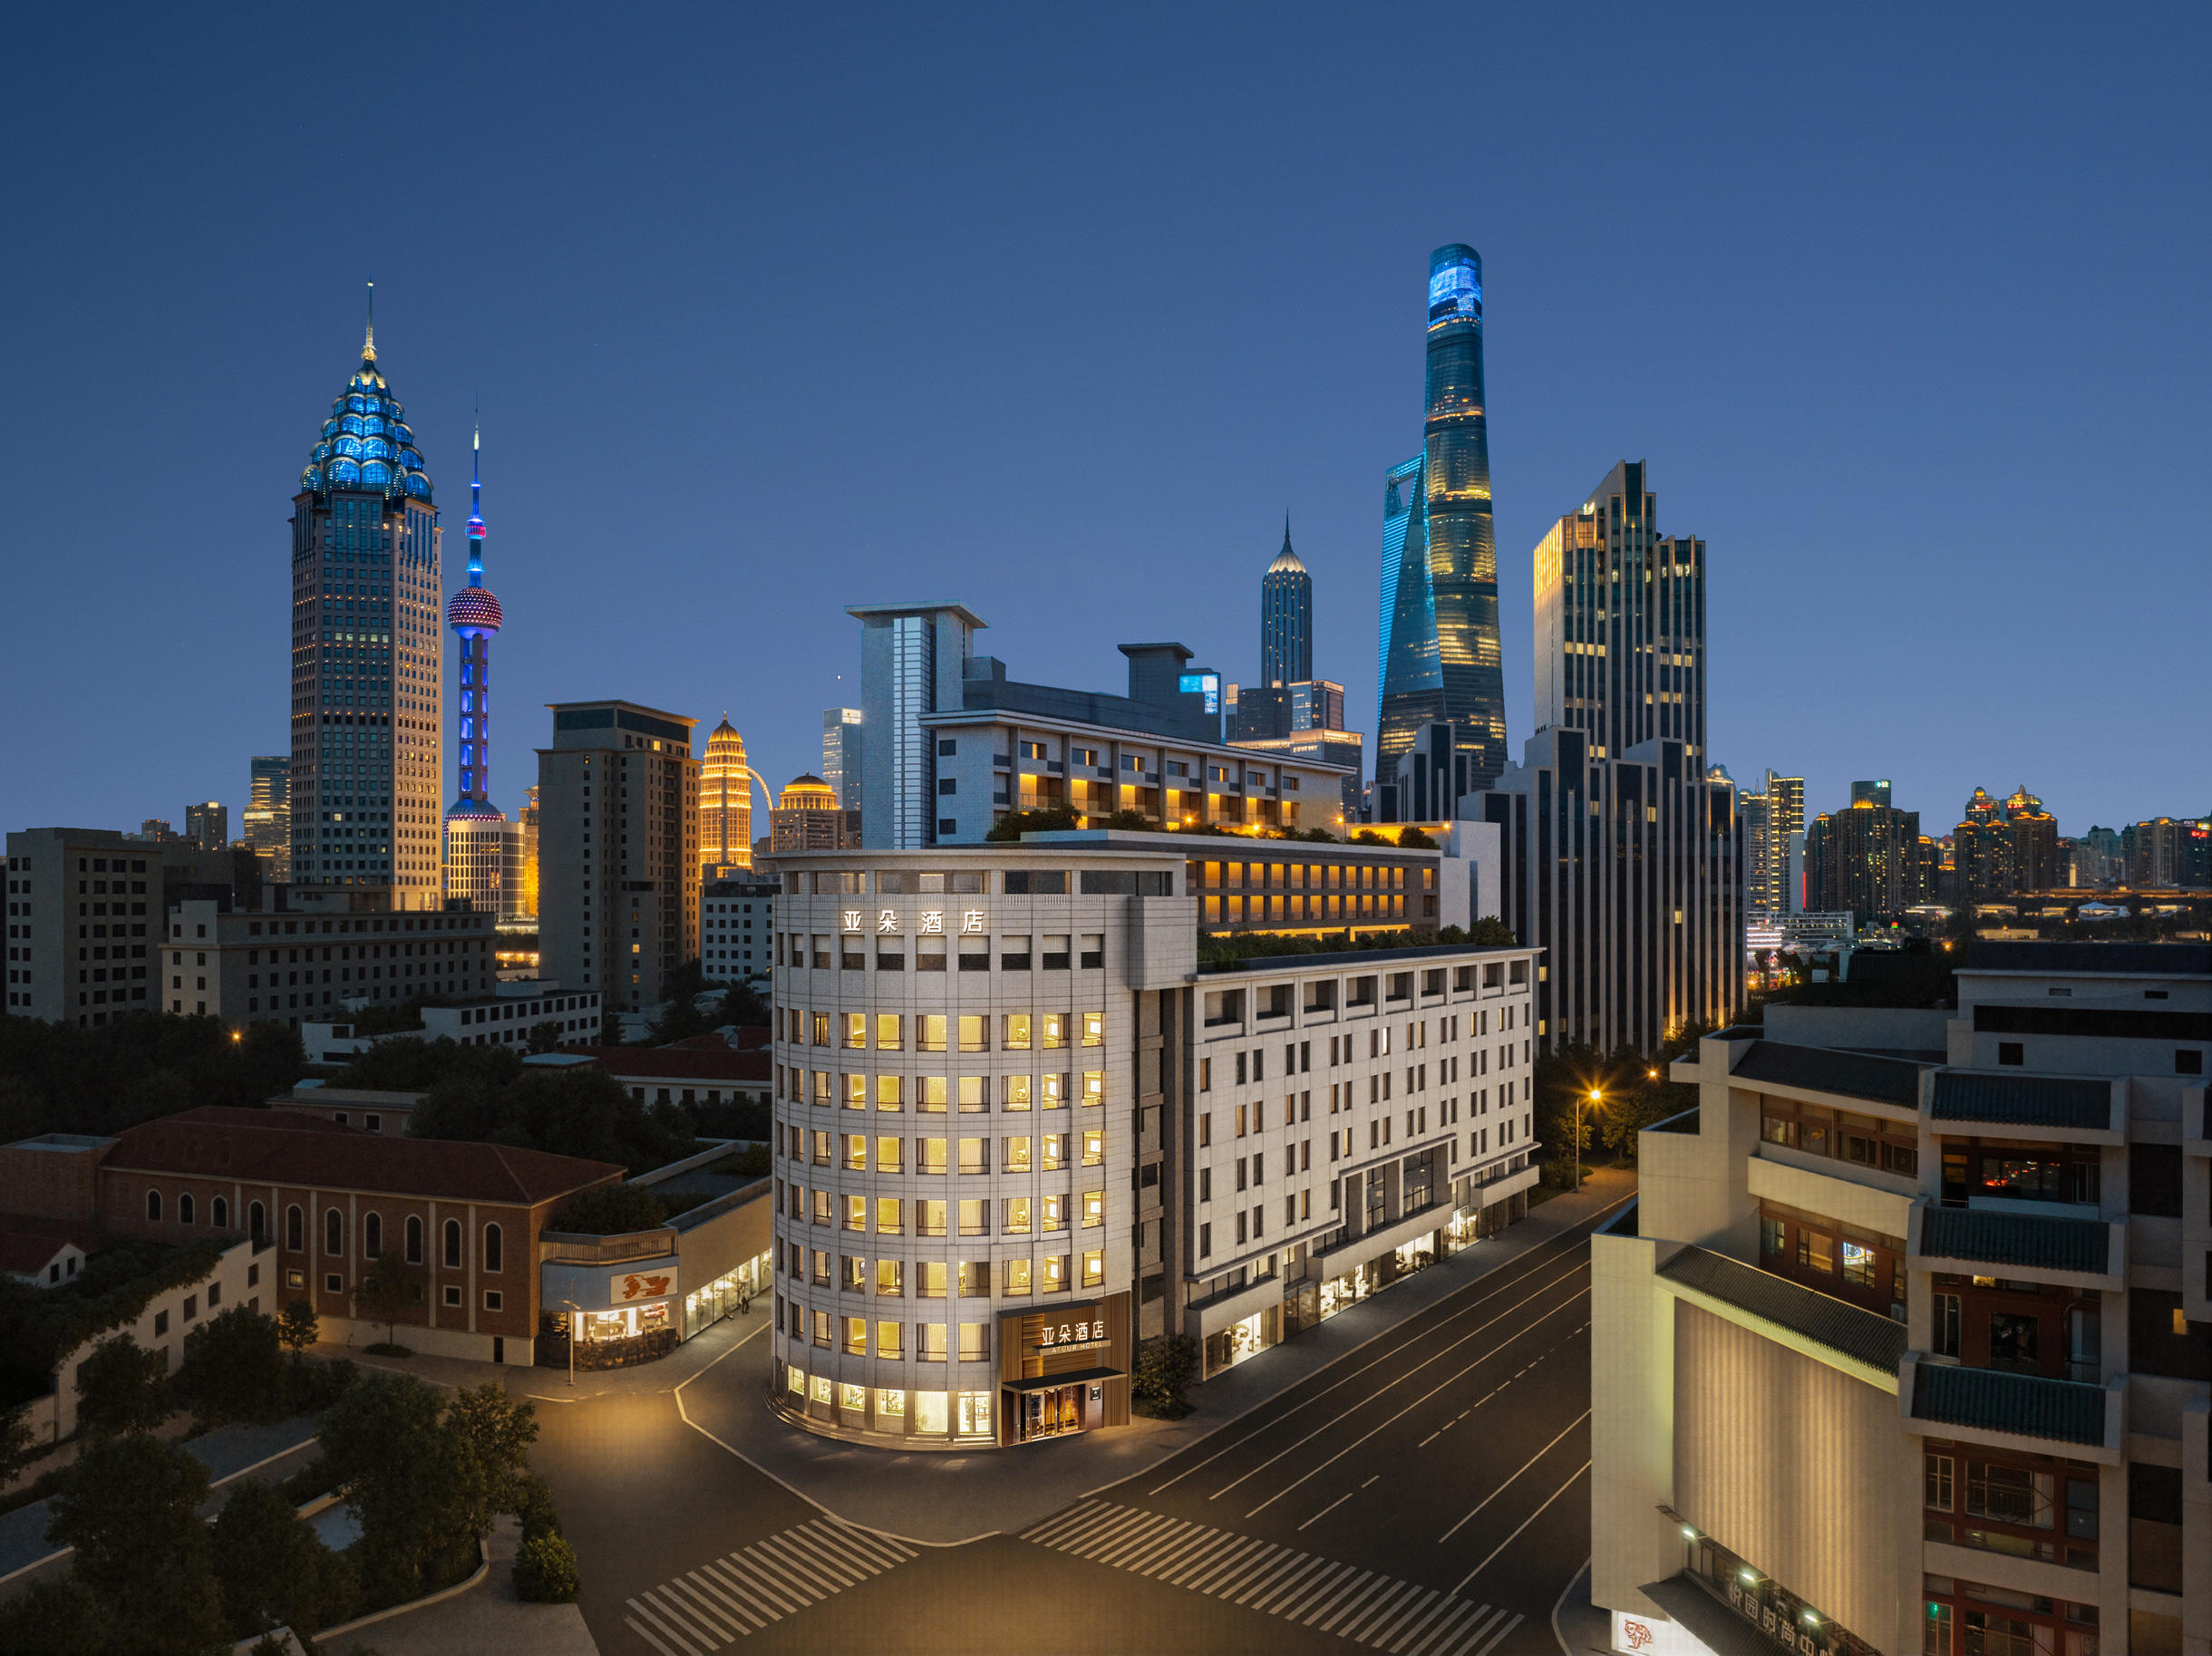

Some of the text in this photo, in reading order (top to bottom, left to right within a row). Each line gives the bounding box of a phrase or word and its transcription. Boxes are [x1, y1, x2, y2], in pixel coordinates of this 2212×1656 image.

[843, 909, 985, 934] 亚朵酒店
[1042, 1320, 1104, 1346] 亚朵酒店
[1052, 1341, 1102, 1353] ATOUR HOTEL
